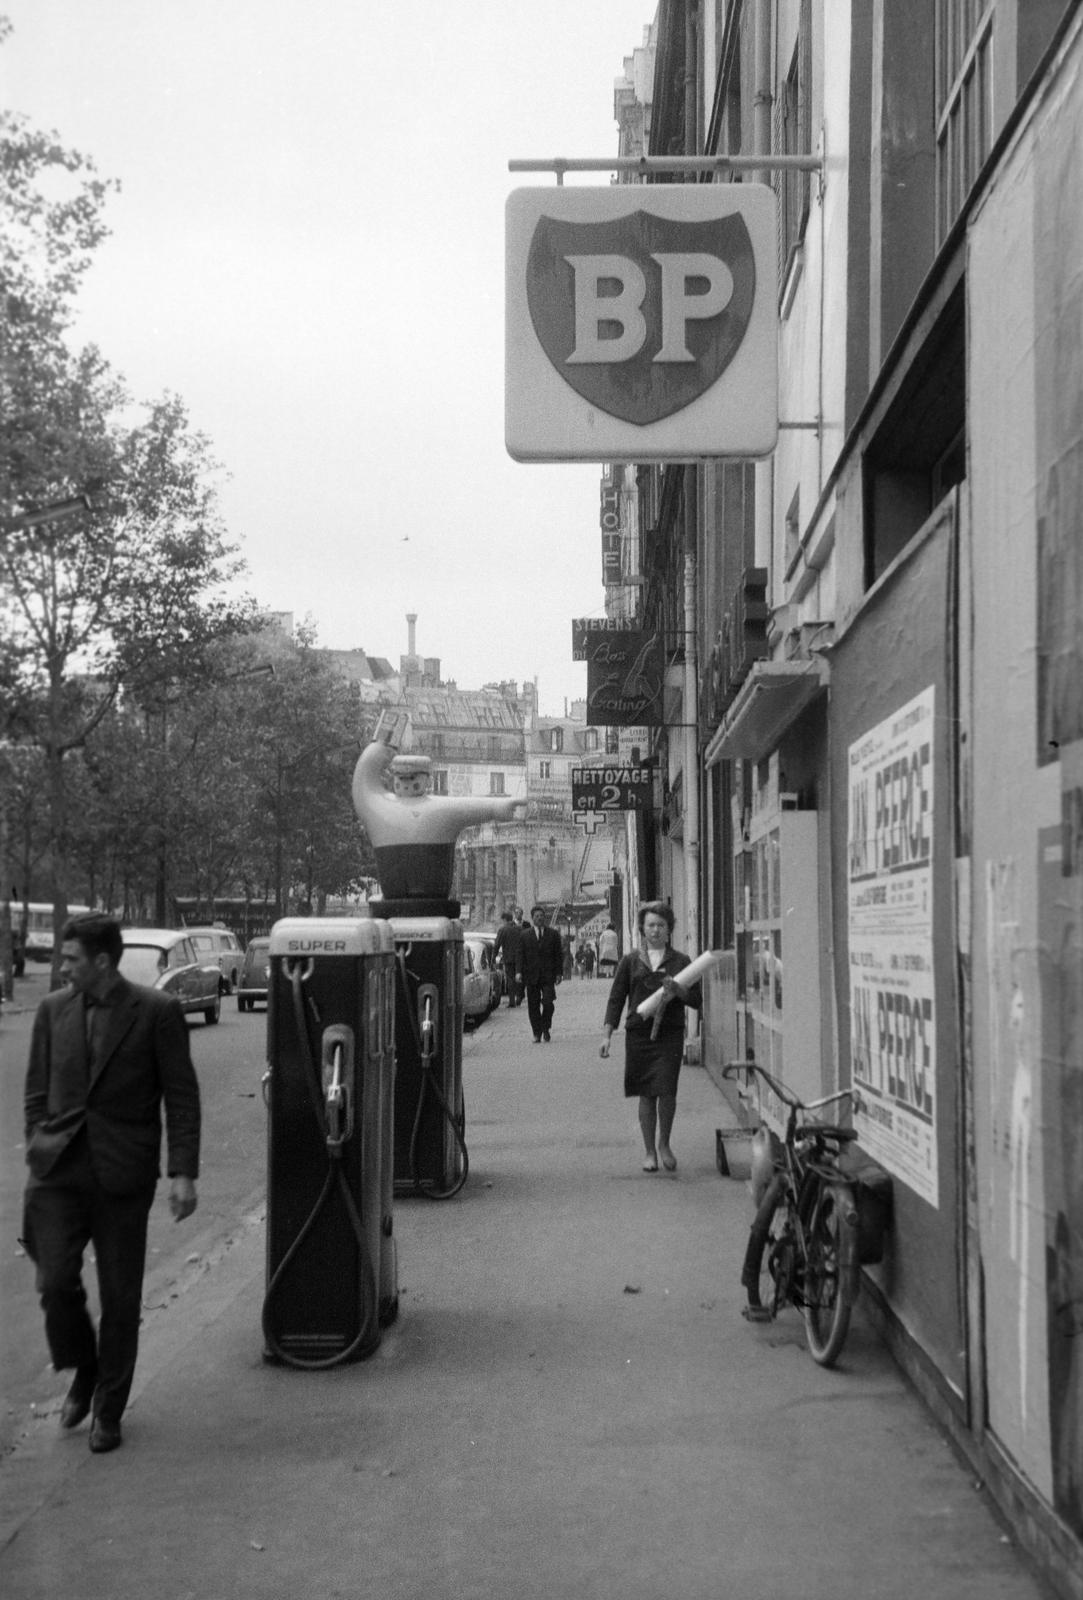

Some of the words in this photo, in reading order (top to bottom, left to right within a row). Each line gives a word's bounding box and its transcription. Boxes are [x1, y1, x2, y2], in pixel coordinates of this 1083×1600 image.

[563, 252, 734, 364] BP
[603, 491, 619, 585] HOTEL
[573, 769, 649, 785] NETTOYAGE
[577, 796, 596, 809] en
[601, 785, 621, 809] 2
[393, 931, 433, 939] ESSENCE
[288, 940, 346, 952] SUPER
